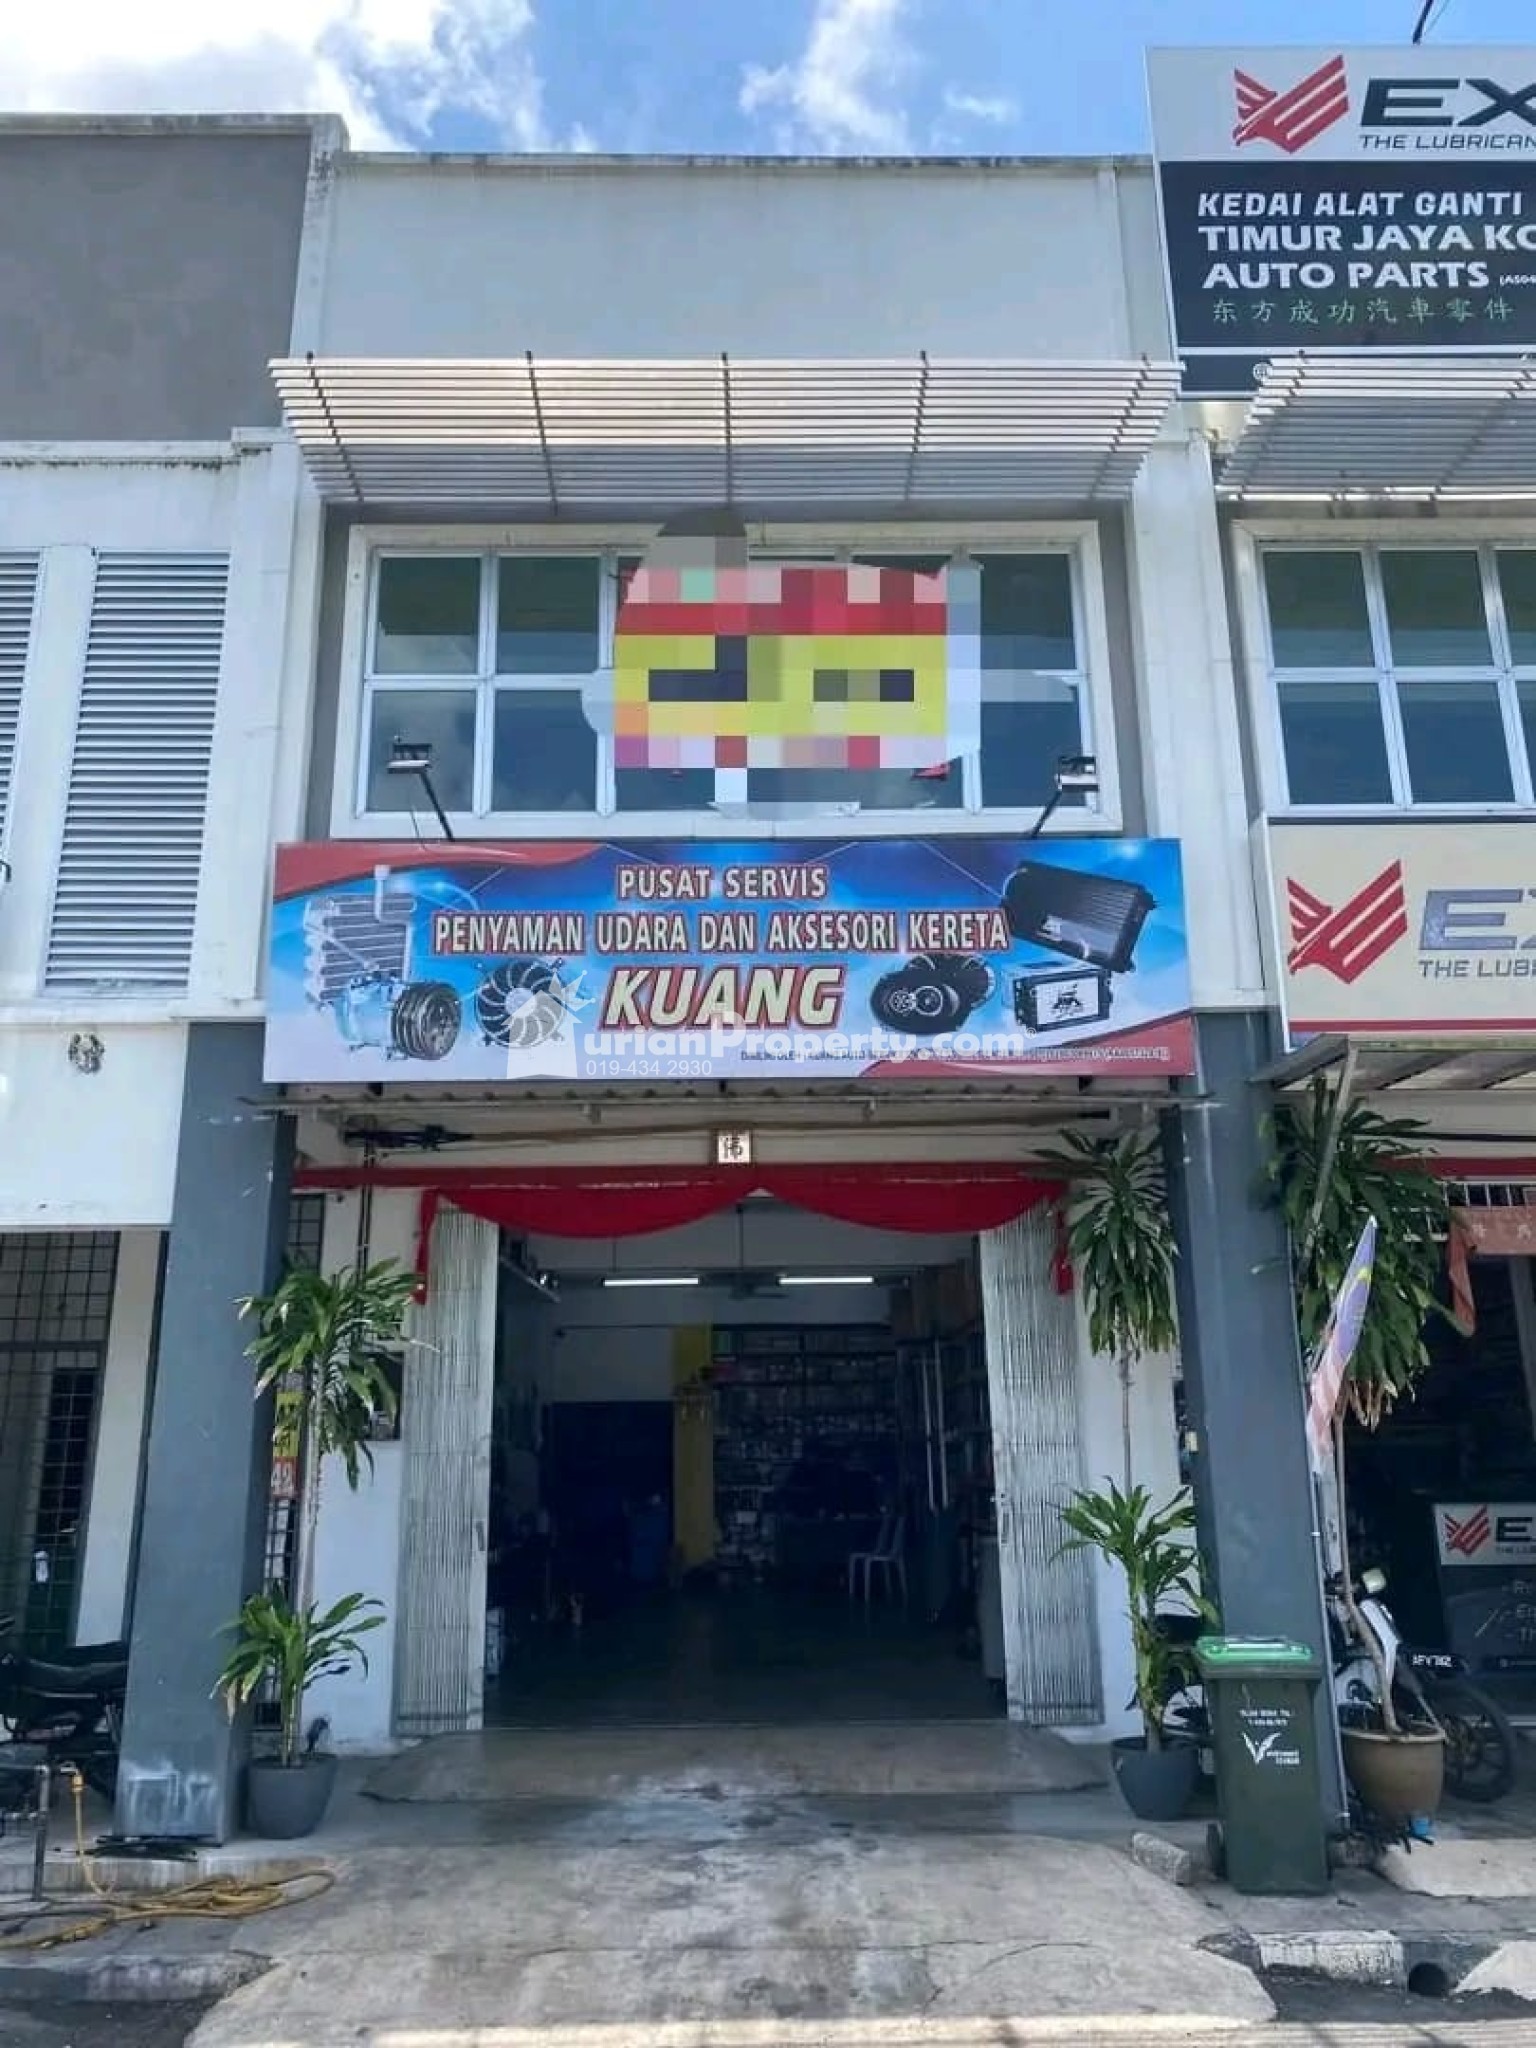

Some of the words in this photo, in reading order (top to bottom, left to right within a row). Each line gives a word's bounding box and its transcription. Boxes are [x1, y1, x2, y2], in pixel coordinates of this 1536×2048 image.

[1359, 134, 1407, 150] THE
[1198, 192, 1302, 217] KEDAI
[1313, 192, 1404, 216] ALAT
[1414, 191, 1523, 216] GANTI
[1198, 225, 1343, 252] TIMUR
[1352, 225, 1475, 251] JAYA
[1201, 262, 1336, 289] AUTO
[1348, 261, 1490, 288] PARTS
[619, 867, 711, 899] PUSAT
[724, 866, 828, 898] SERVIS
[433, 914, 585, 952] PENYAMAN
[597, 914, 688, 952] UDARA
[699, 914, 756, 951] DAN
[767, 914, 897, 951] AKSESORI
[908, 913, 1010, 950] KERETA
[1419, 889, 1536, 950] E
[1418, 959, 1470, 978] THE
[603, 967, 844, 1028] KUANG
